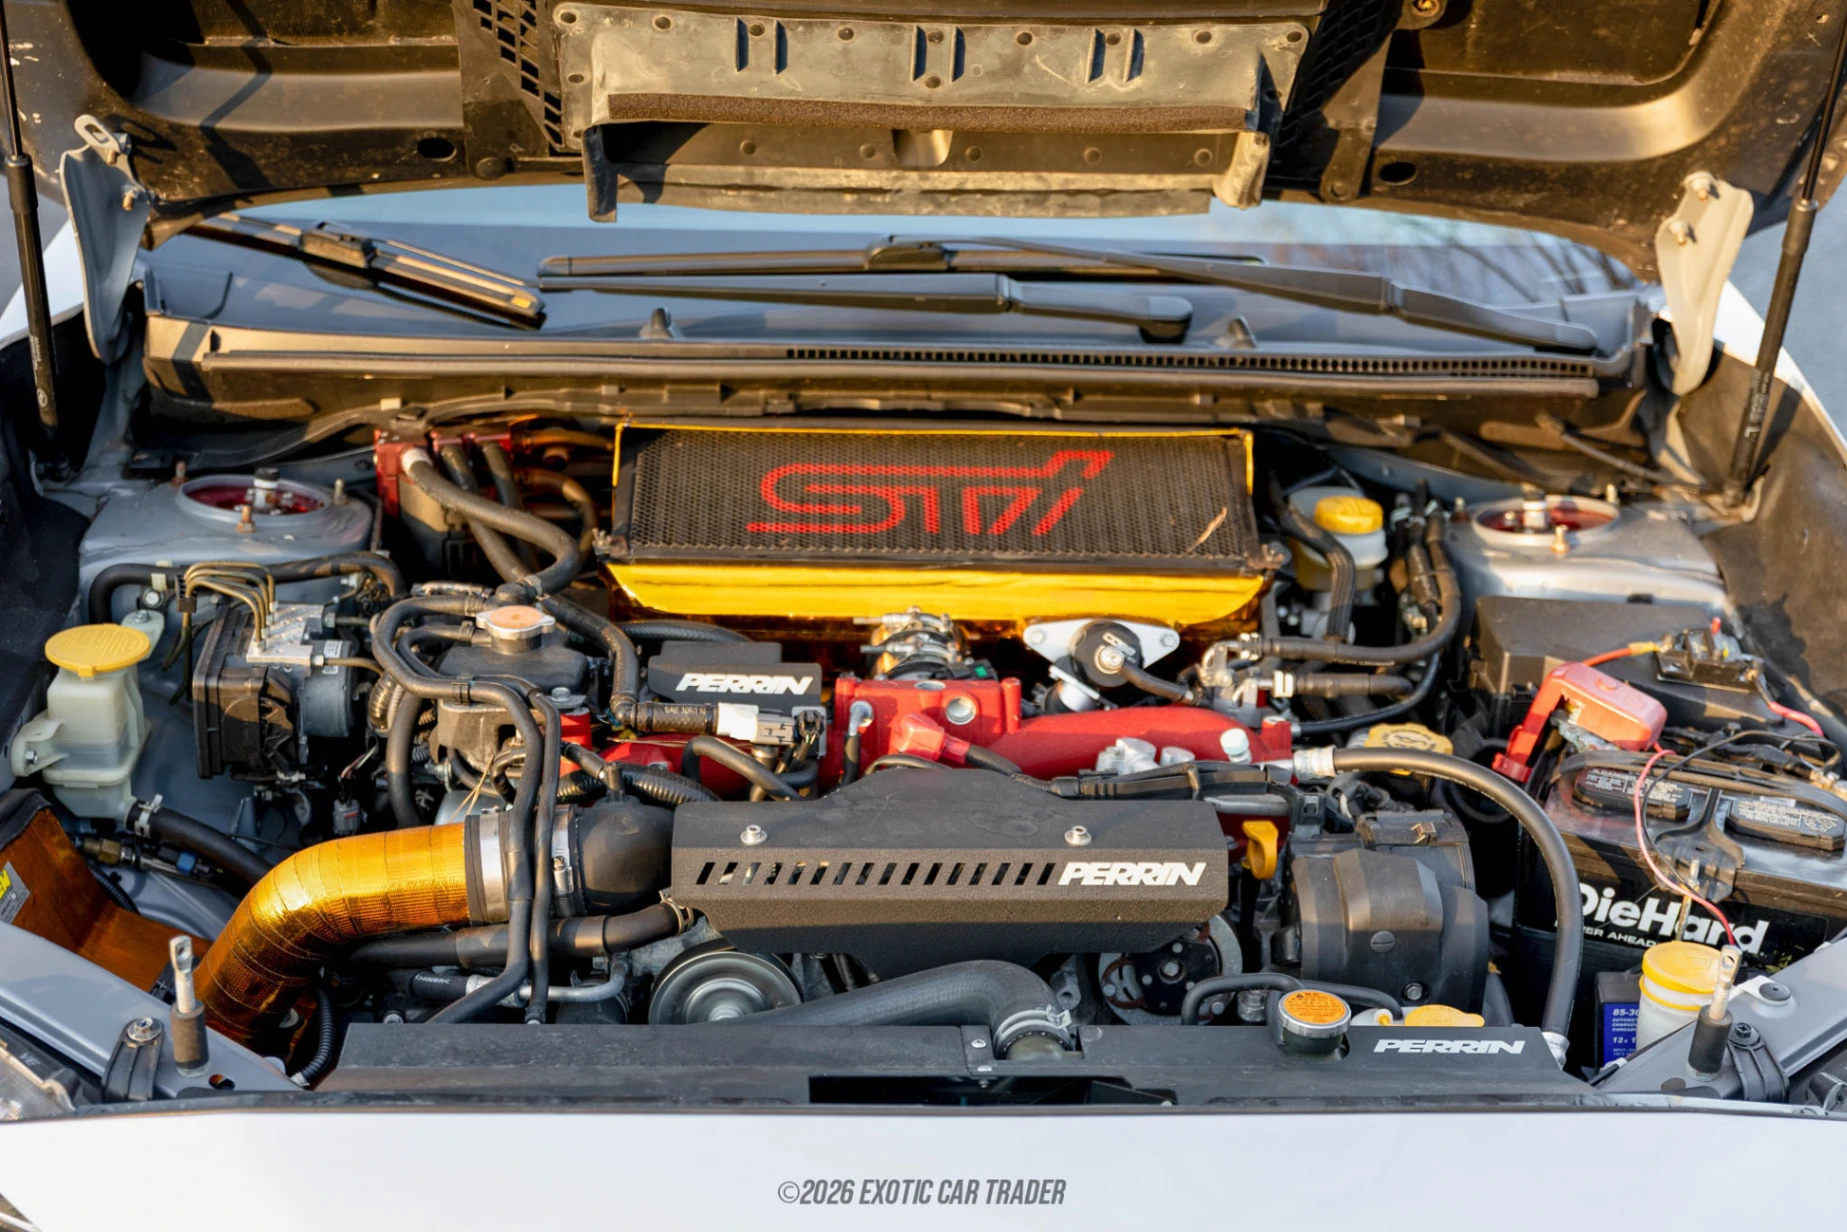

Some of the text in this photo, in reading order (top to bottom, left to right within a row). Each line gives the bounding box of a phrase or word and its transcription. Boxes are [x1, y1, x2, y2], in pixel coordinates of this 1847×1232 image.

[675, 672, 814, 695] PERRIN
[1057, 861, 1207, 886] PERRIN
[1373, 1039, 1526, 1054] PERRIN
